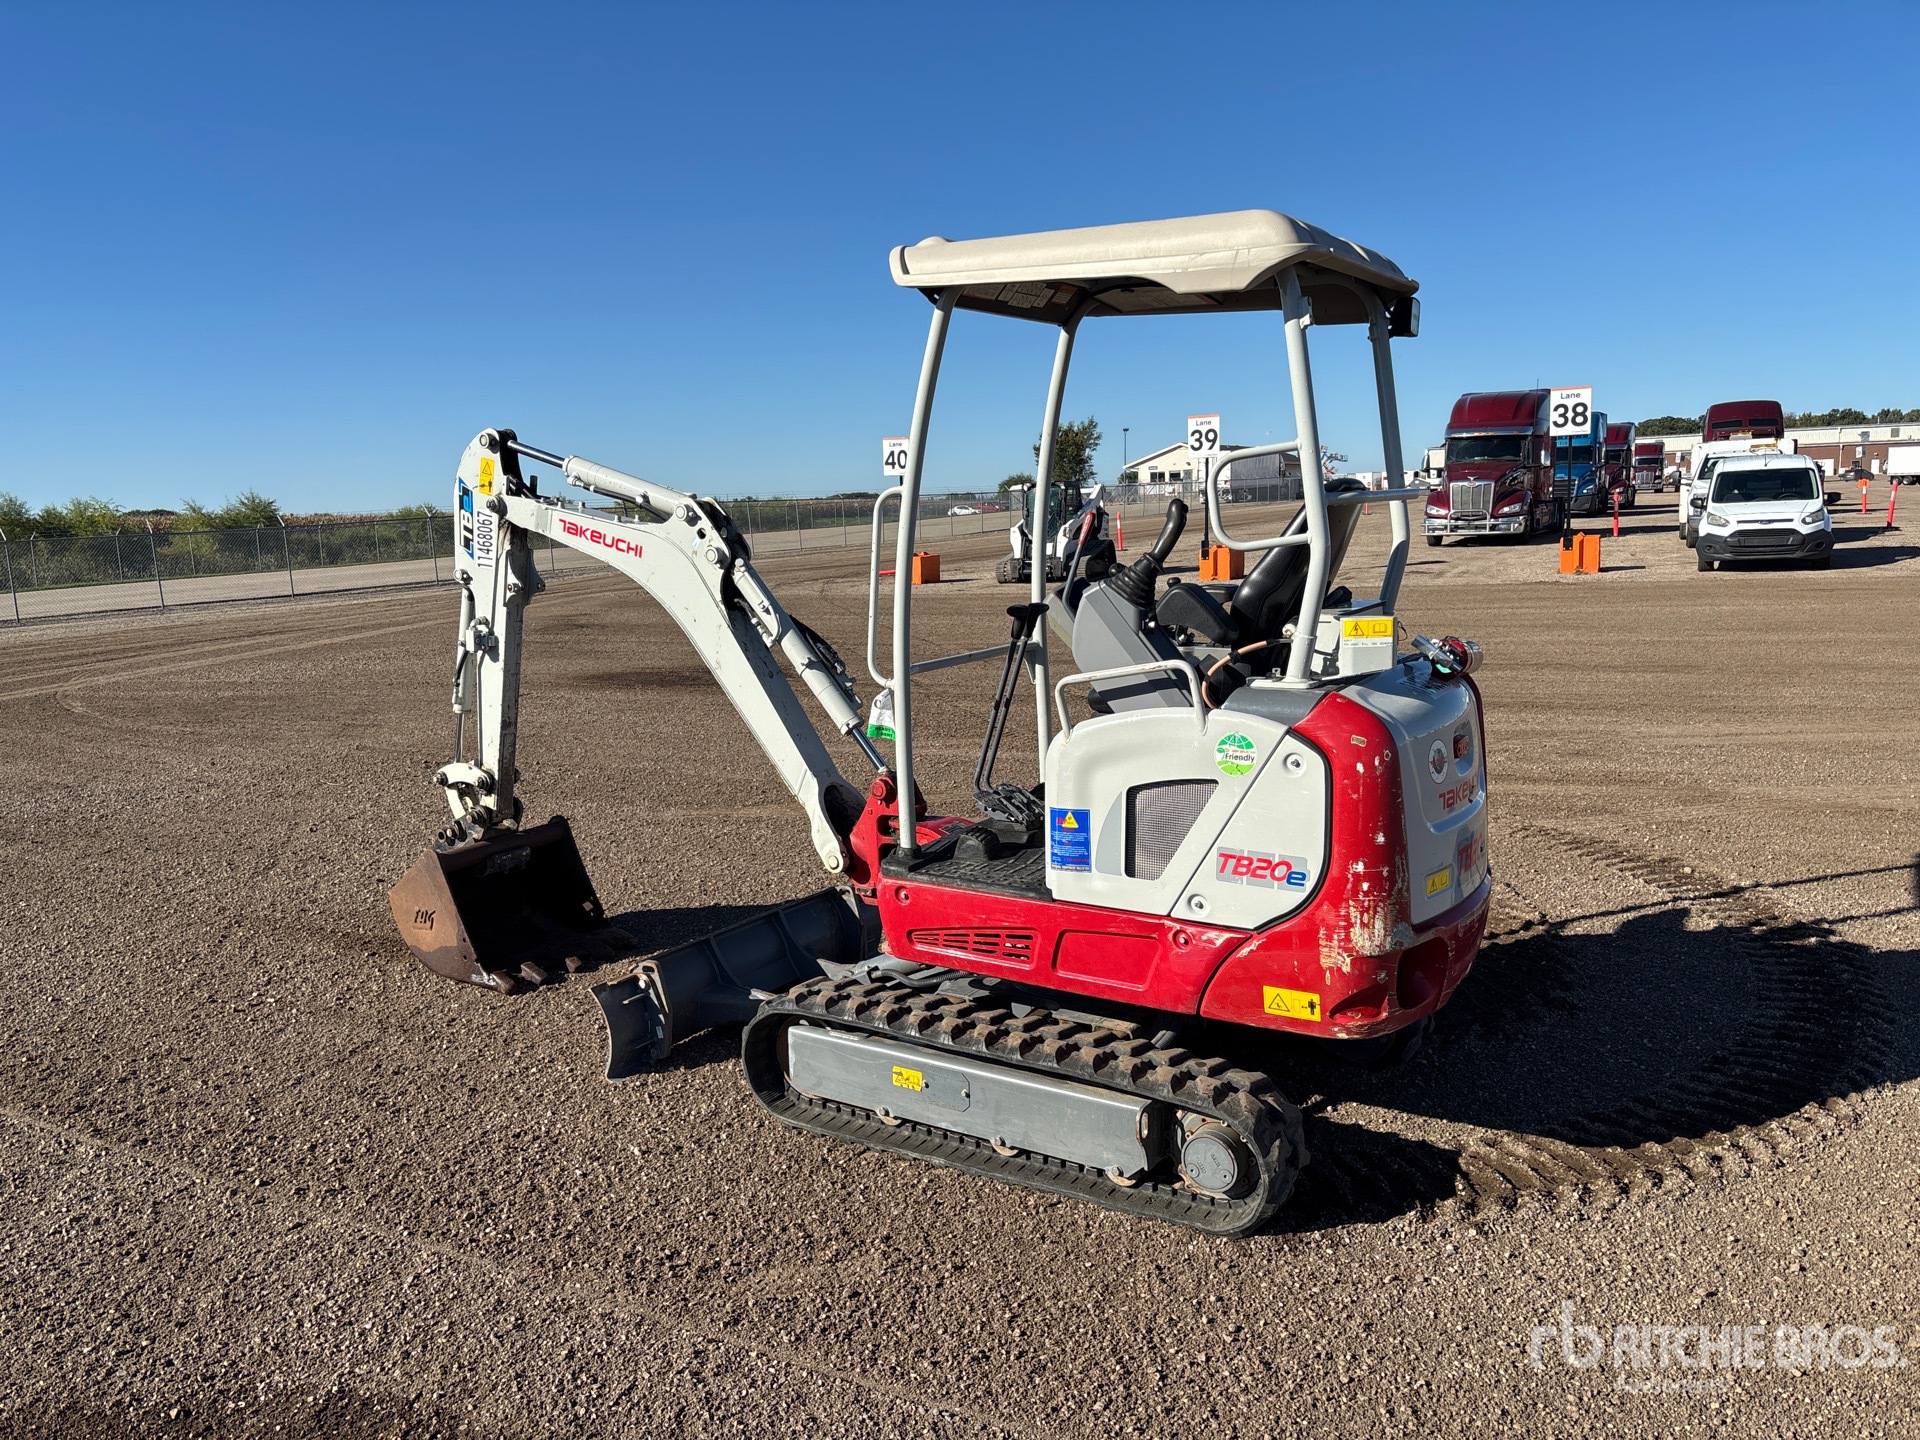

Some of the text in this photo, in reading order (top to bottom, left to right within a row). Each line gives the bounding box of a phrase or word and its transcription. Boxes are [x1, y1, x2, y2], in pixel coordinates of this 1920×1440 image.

[1552, 402, 1589, 428] 38
[1190, 428, 1218, 451] 39
[884, 449, 908, 469] 40
[477, 511, 493, 567] 11468067
[1225, 753, 1255, 763] Friendly
[1218, 852, 1307, 887] TB20e
